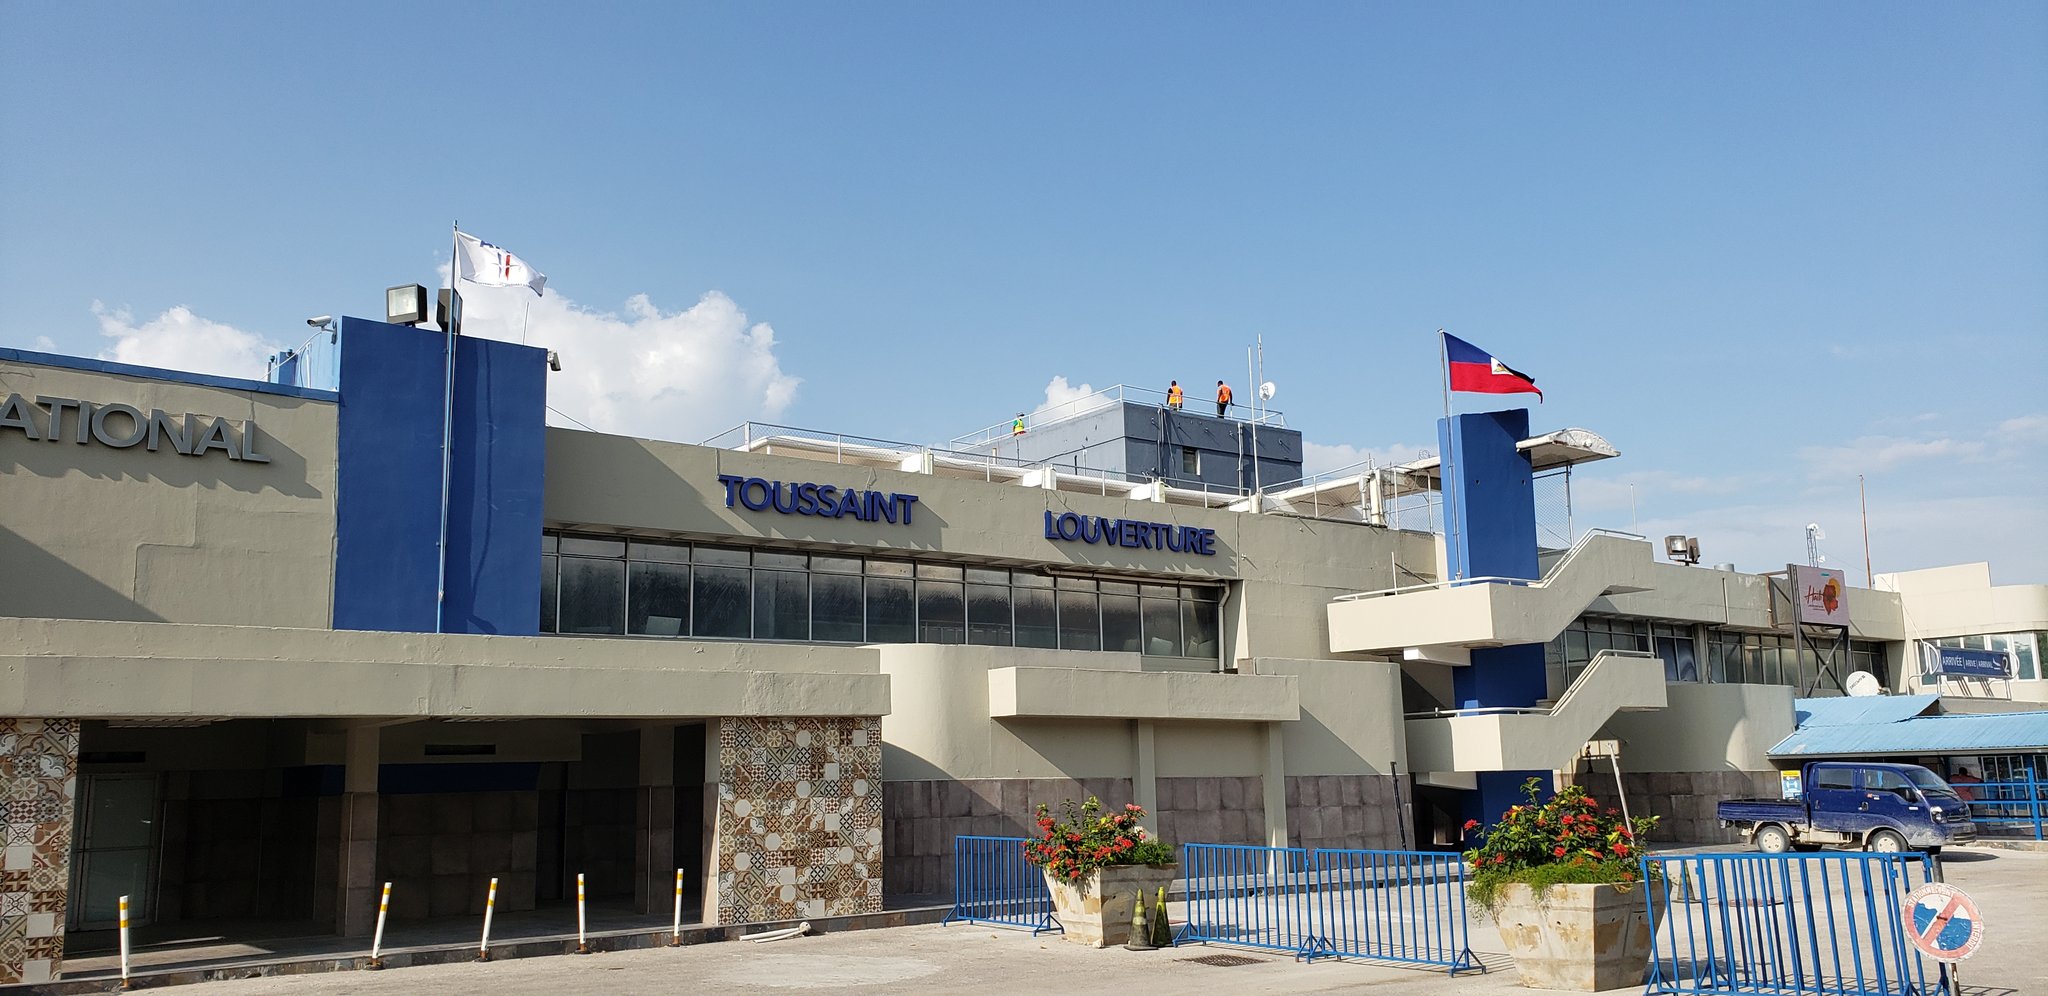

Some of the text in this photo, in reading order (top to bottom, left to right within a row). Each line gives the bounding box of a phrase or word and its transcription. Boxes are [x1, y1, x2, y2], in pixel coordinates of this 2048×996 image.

[717, 474, 919, 525] TOUSSAINT
[1044, 510, 1217, 556] LOUVERTURE
[1966, 921, 1981, 950] INTERDIT
